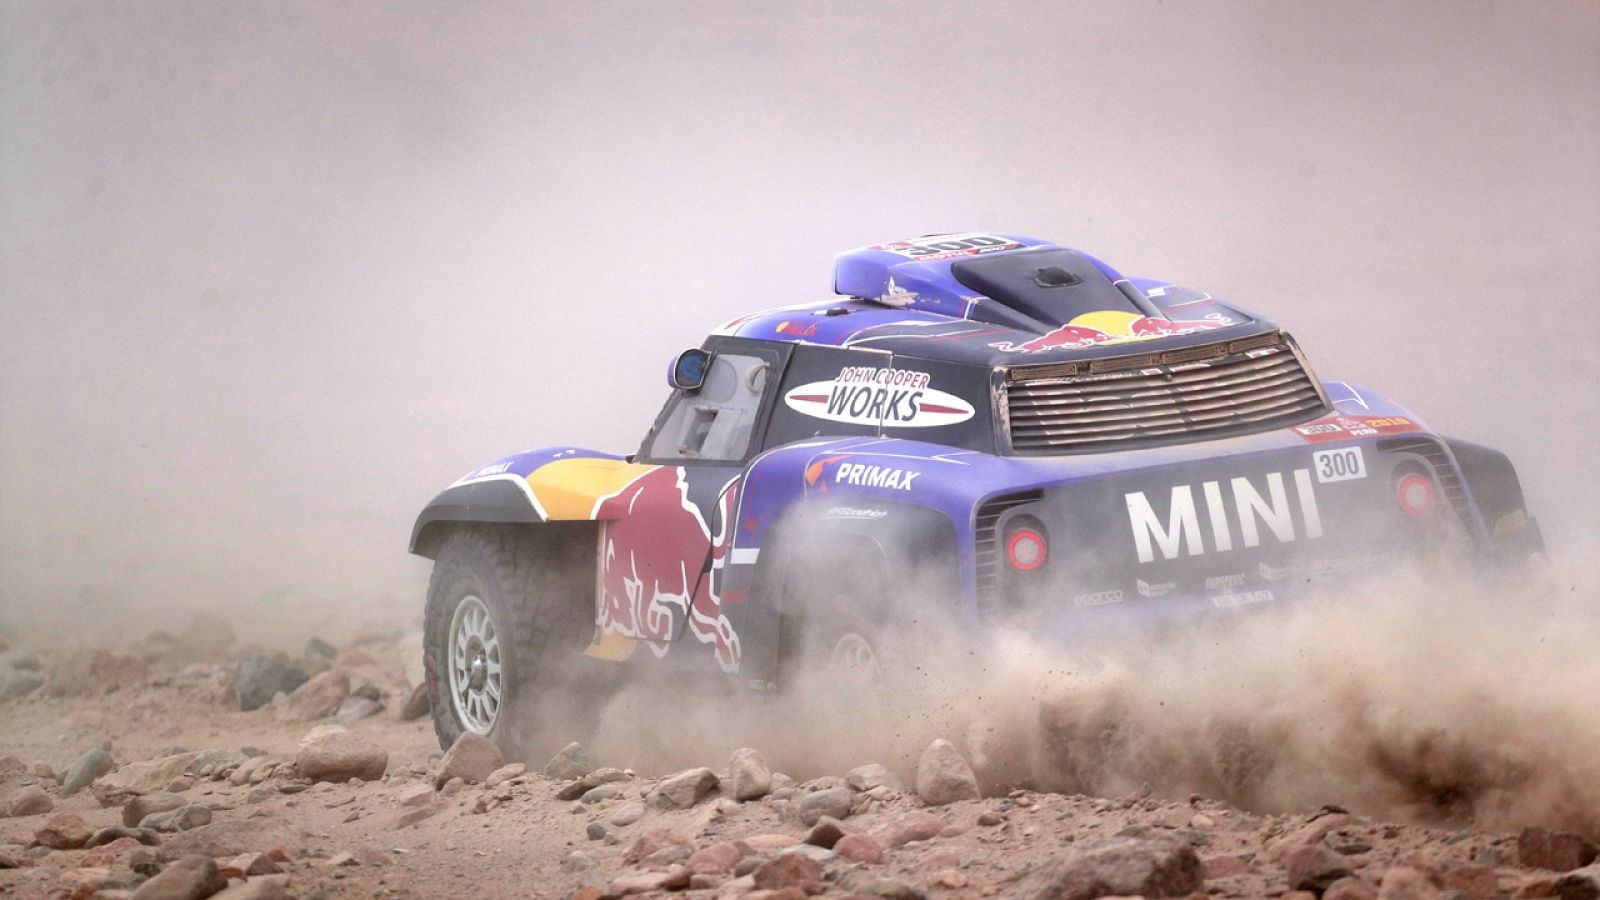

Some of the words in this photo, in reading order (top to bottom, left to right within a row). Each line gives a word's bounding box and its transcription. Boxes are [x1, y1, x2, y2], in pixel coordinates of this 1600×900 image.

[902, 237, 1007, 255] 300
[836, 367, 875, 384] JOHN
[876, 370, 930, 390] COOPER
[827, 386, 923, 422] WORKS
[836, 463, 920, 491] PRIMAX
[1319, 451, 1360, 478] 300
[1125, 468, 1323, 564] MINI
[1074, 589, 1124, 608] sparco
